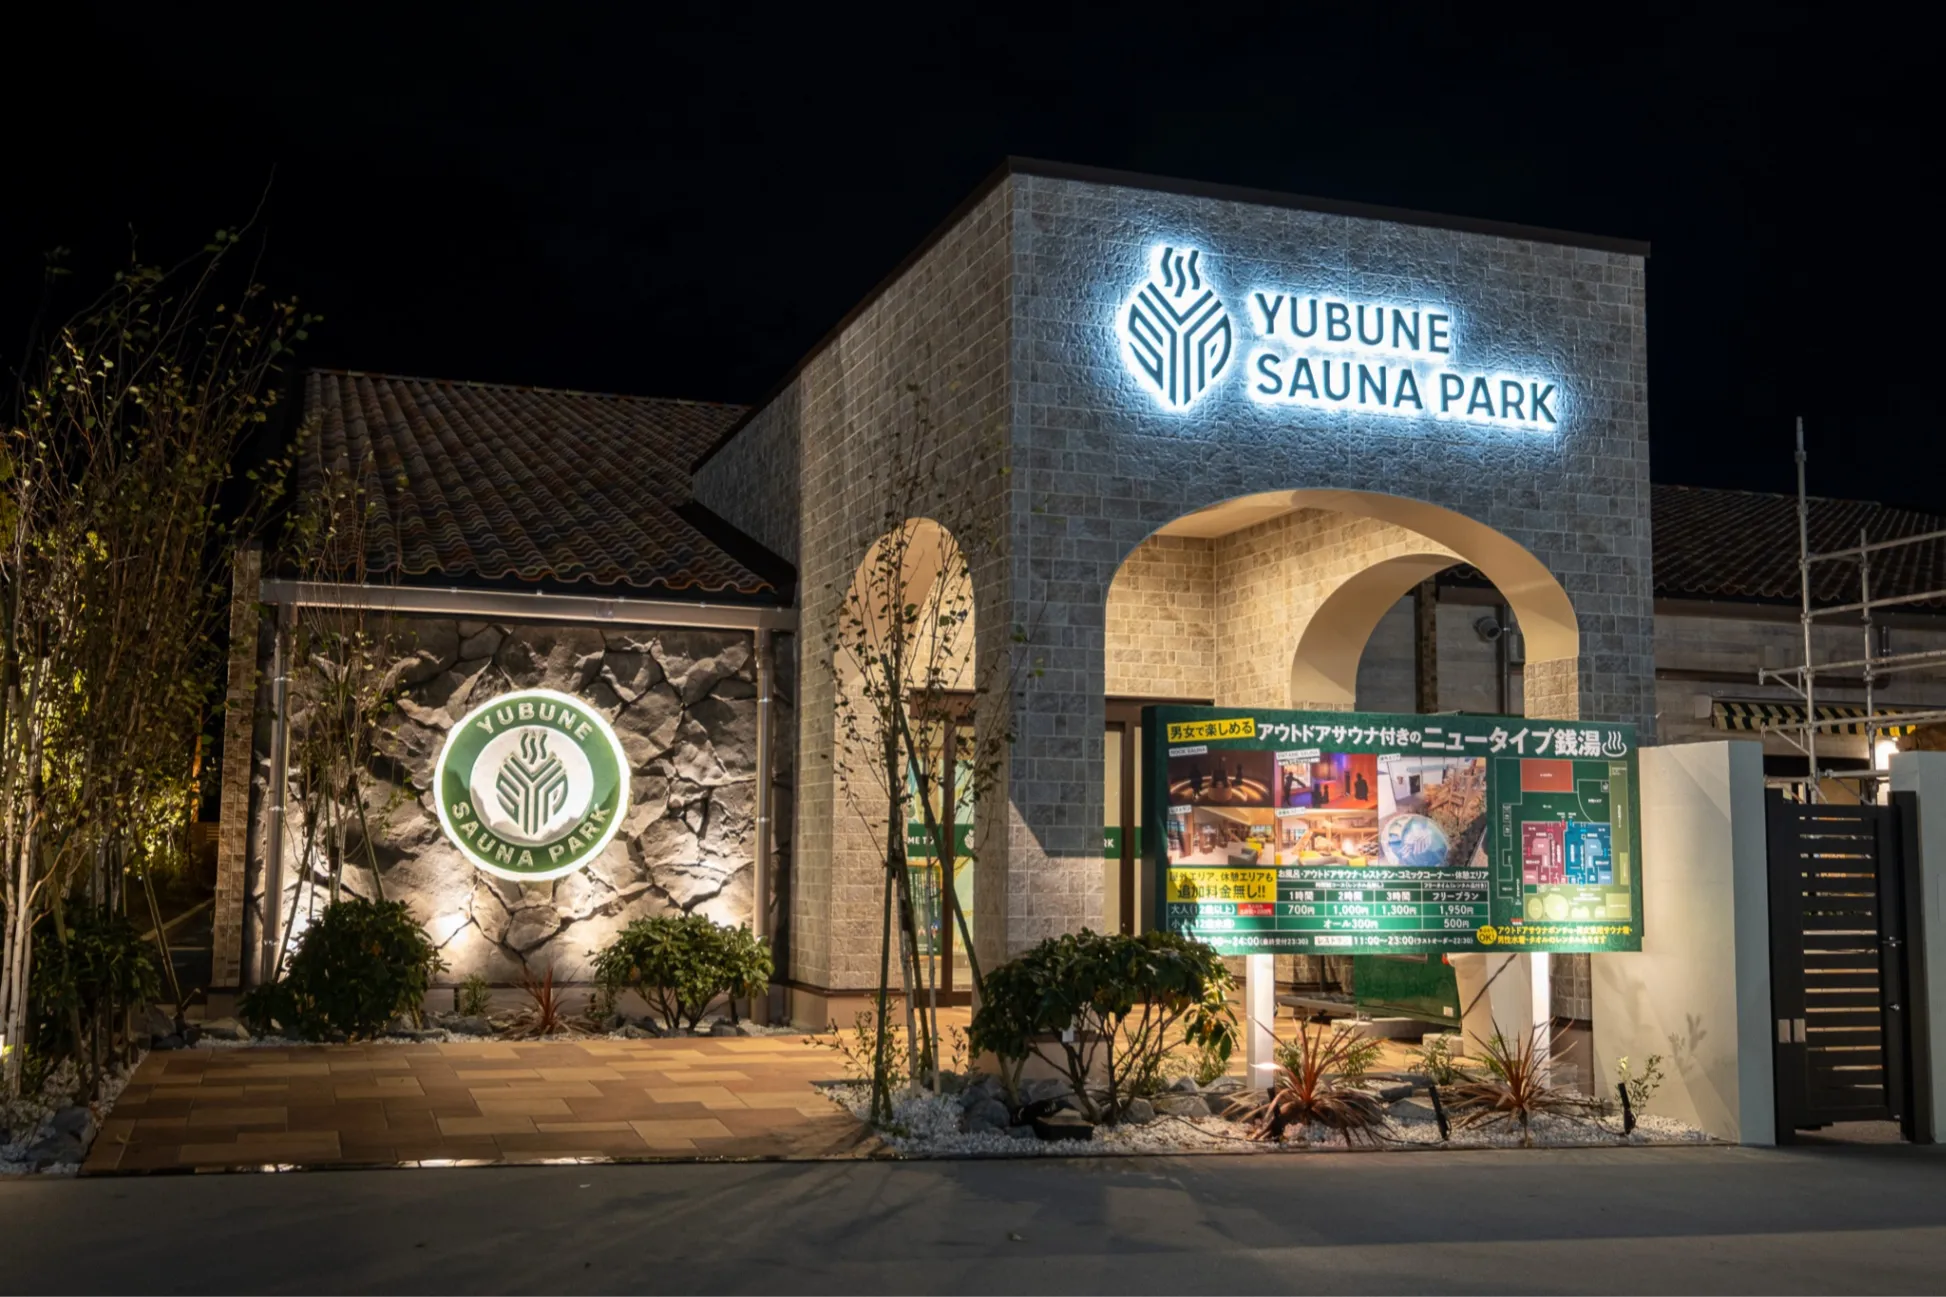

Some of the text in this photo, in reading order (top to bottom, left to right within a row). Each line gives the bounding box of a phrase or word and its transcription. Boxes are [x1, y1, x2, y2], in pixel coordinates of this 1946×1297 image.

[1254, 291, 1451, 355] YUBUNE
[1255, 352, 1558, 424] SAUNA PARK
[476, 702, 594, 742] YUBUNE
[1170, 720, 1601, 757] 男女で楽しめる アウトドアサウナ付きのニュータイプ銭湯
[451, 801, 611, 868] SAUNA PARK
[1289, 890, 1315, 902] 1時間
[1338, 891, 1363, 902] 2時間
[1386, 891, 1411, 902] 3時間
[1432, 892, 1479, 902] フリープラン
[1288, 904, 1315, 916] 700円
[1333, 905, 1369, 916] 1,000円
[1382, 905, 1417, 916] 1,300円
[1439, 905, 1474, 916] 1,950円
[1323, 918, 1378, 929] オール300円
[1443, 918, 1470, 929] 500円
